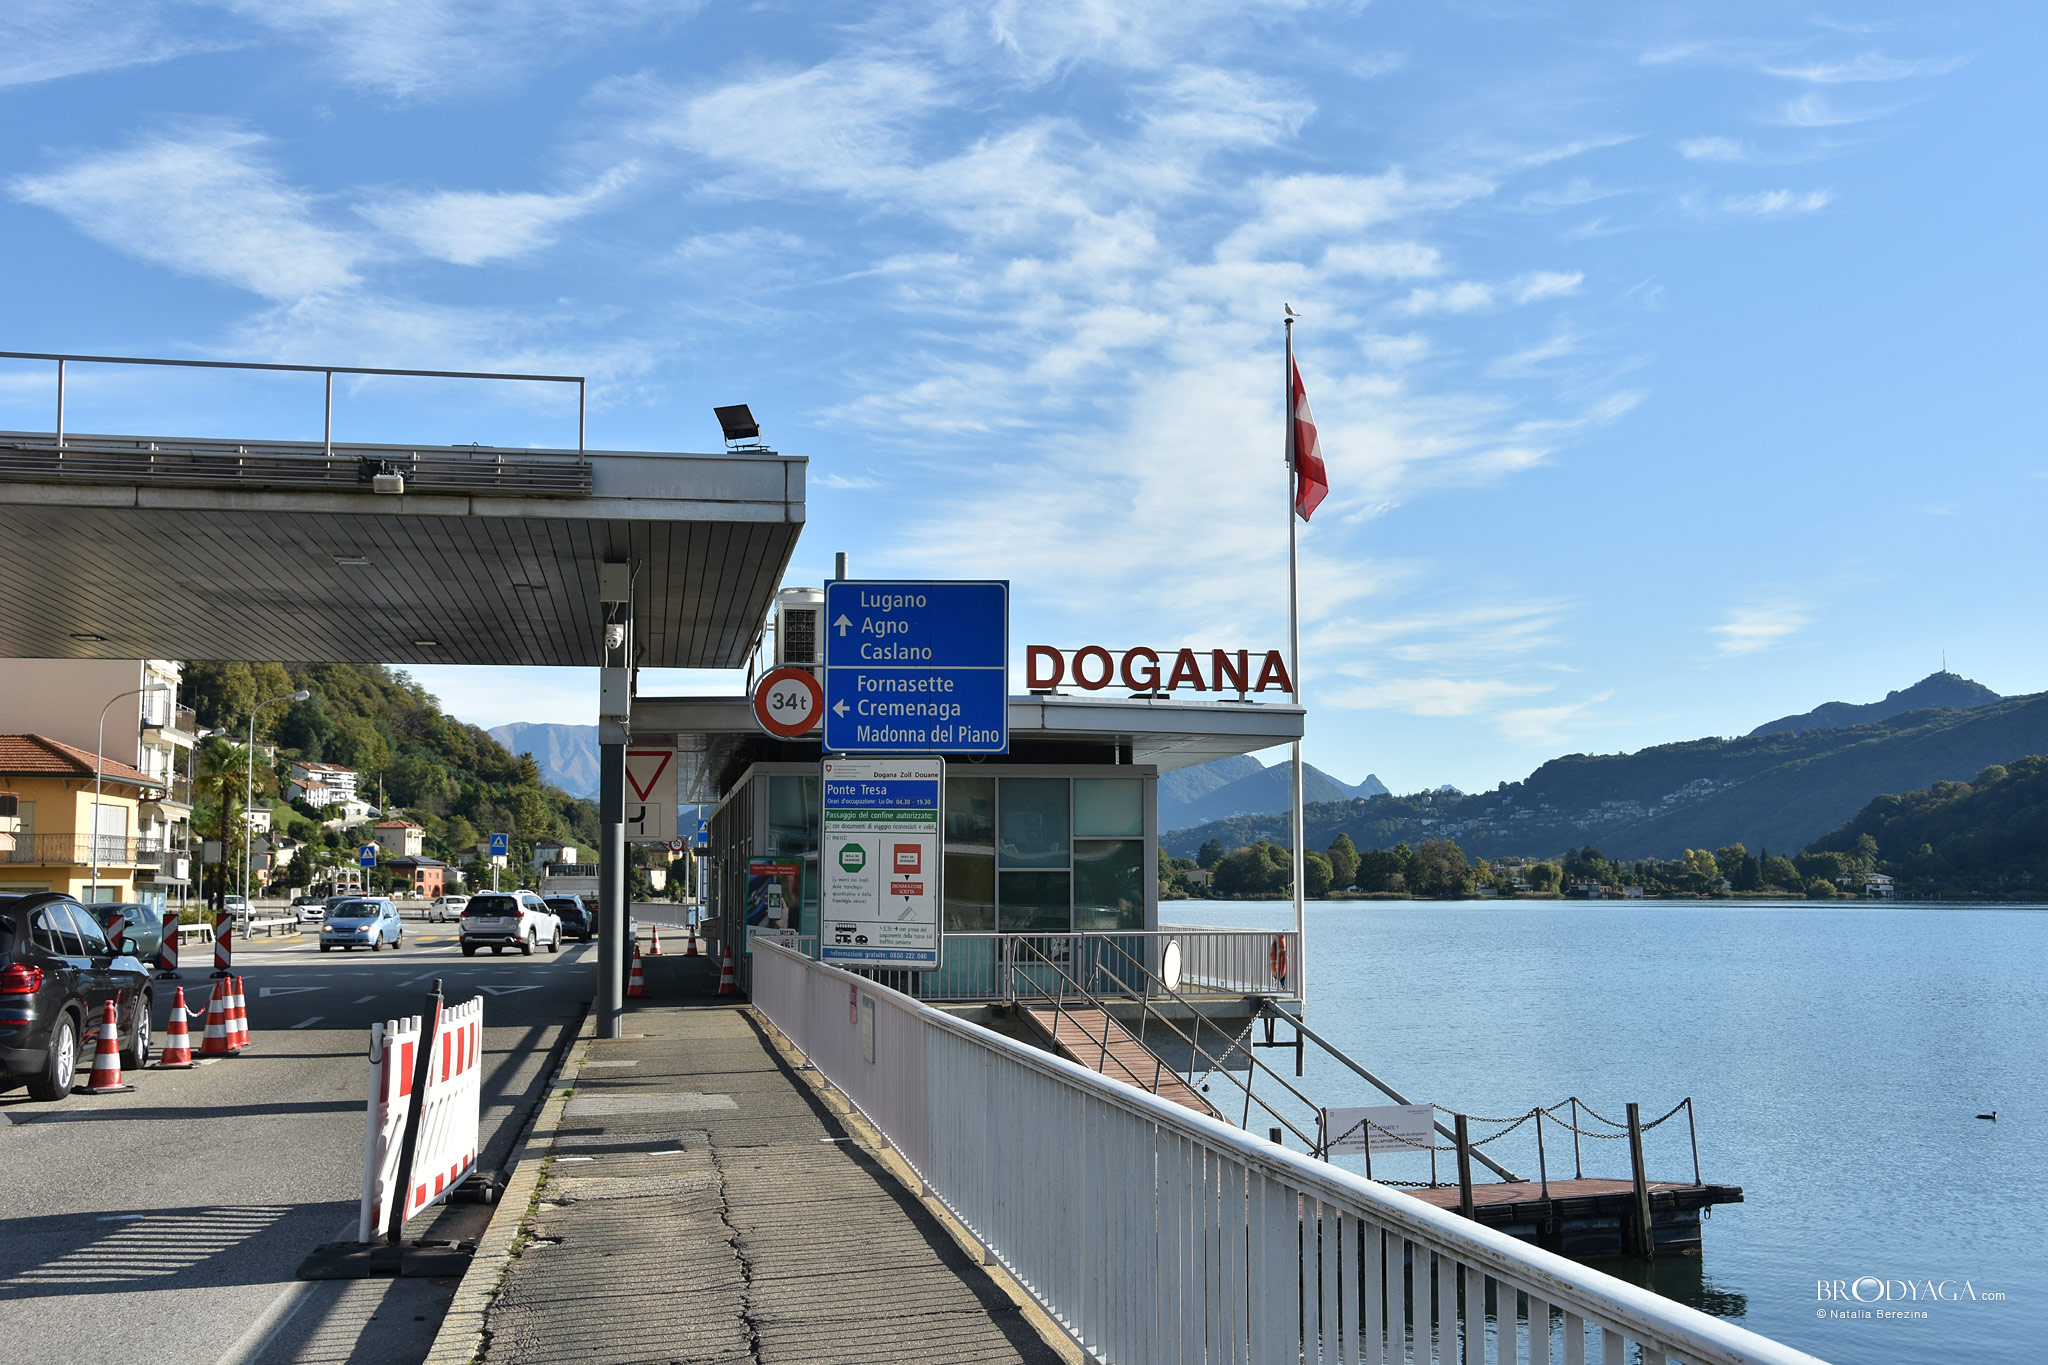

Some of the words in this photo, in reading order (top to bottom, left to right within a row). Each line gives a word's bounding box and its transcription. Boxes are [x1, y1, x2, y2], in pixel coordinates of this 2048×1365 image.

[861, 591, 926, 612] Lugano
[861, 617, 908, 638] Agno
[860, 642, 932, 660] Caslano
[1026, 644, 1294, 693] DOGANA
[858, 675, 954, 692] Fornasette
[858, 700, 961, 720] Cremenaga
[857, 725, 925, 742] Madonna
[931, 725, 952, 742] del
[958, 726, 999, 743] Piano
[827, 784, 856, 795] Ponte
[861, 784, 887, 795] Tresa
[826, 812, 856, 820] Passaggio
